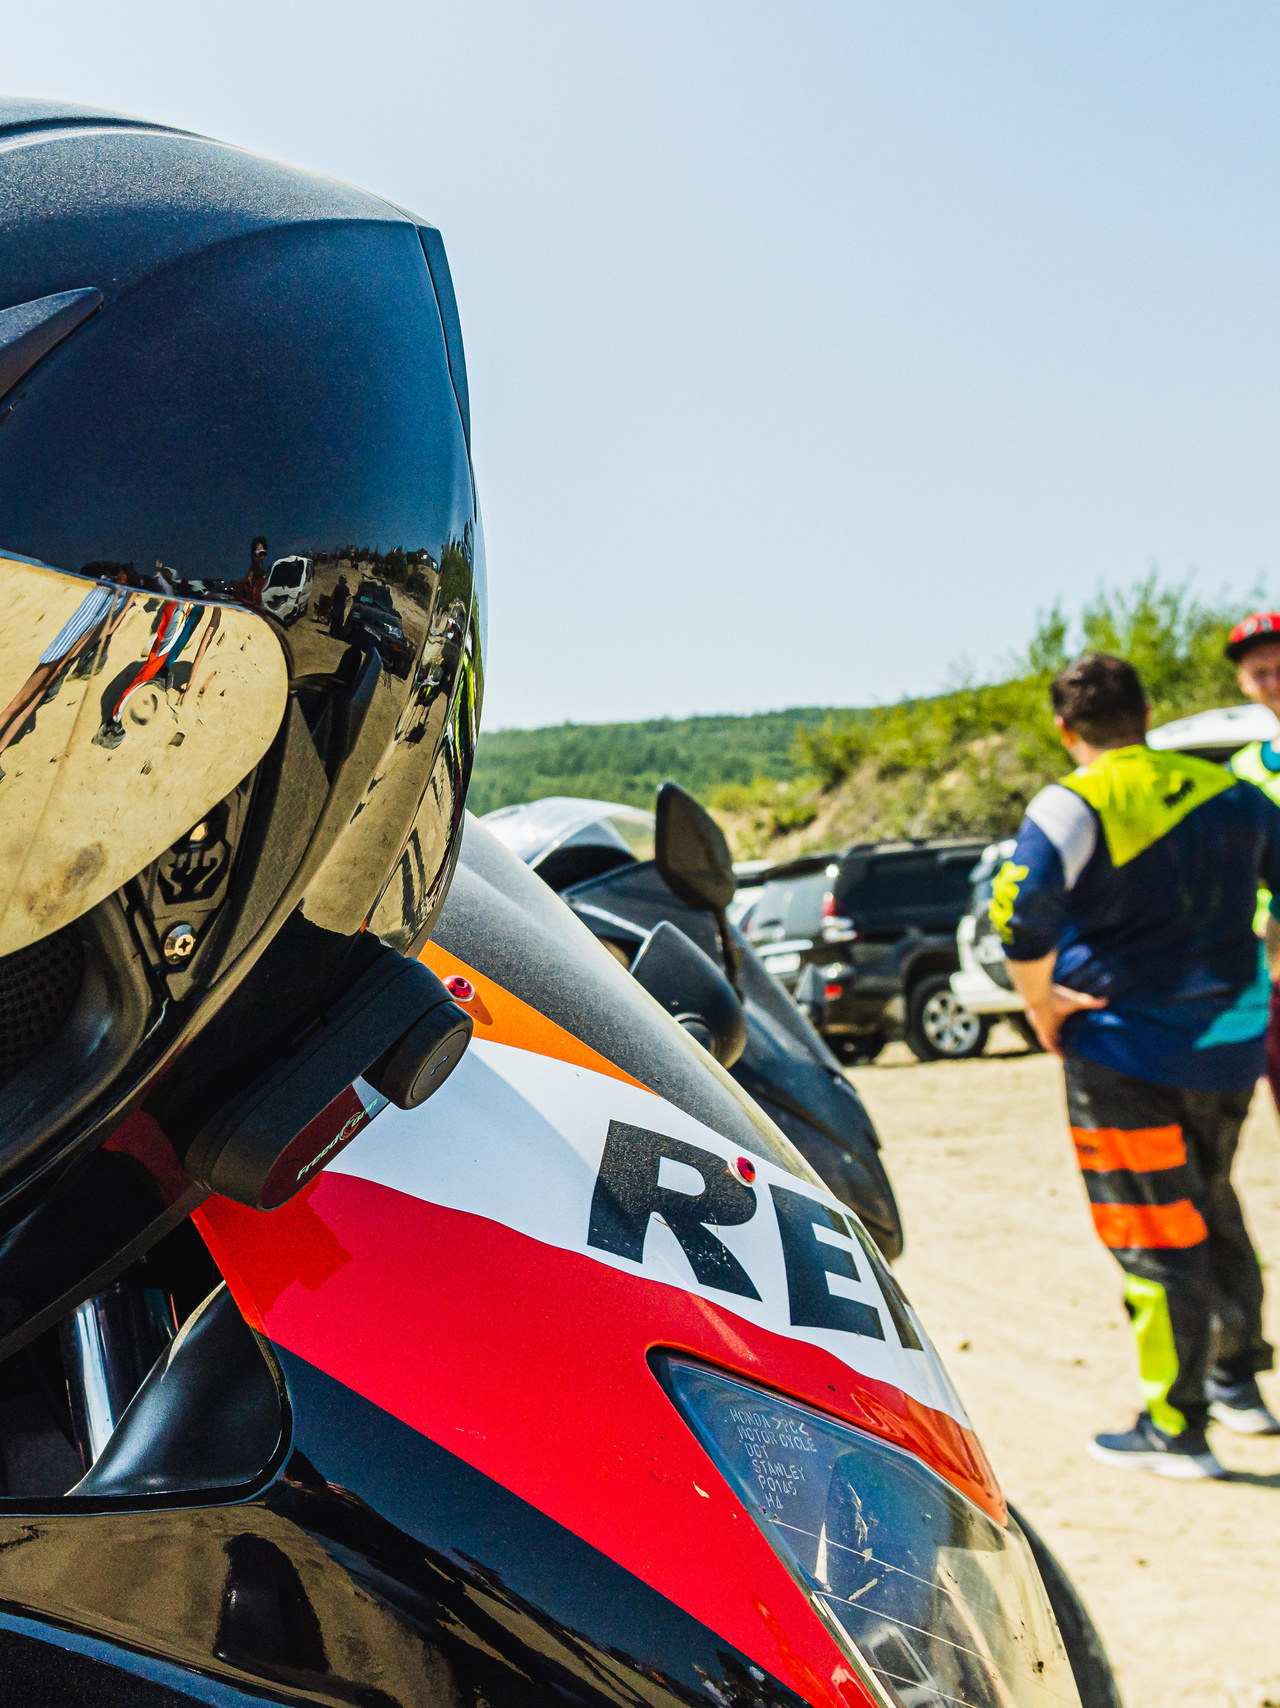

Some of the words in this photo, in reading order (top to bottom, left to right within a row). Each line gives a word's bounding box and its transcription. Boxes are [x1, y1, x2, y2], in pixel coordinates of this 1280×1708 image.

[729, 1408, 771, 1429] HONDA
[744, 1442, 769, 1459] DOT
[751, 1458, 806, 1481] STANLEY
[764, 1492, 784, 1510] H4
